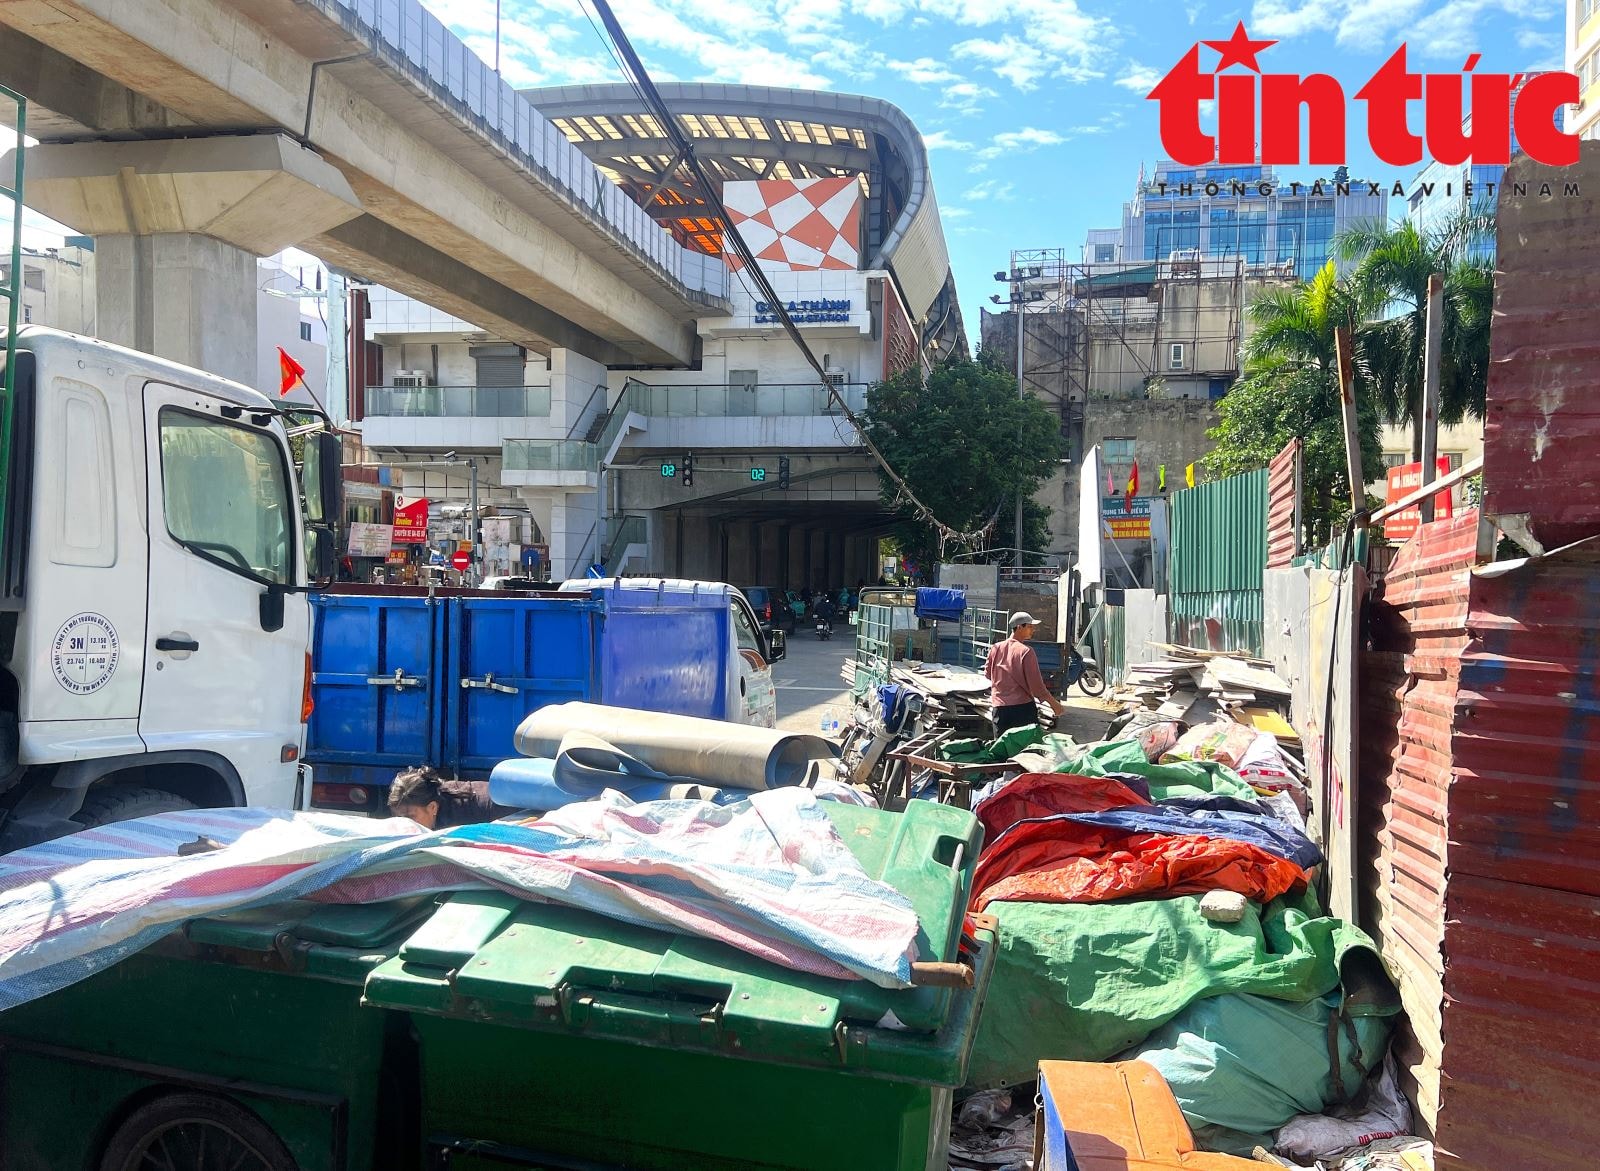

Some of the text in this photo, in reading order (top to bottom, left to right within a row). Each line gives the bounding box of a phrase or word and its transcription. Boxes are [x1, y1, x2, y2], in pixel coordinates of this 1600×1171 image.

[800, 297, 850, 312] THÀNH
[806, 313, 849, 323] STATION
[661, 464, 676, 476] 02
[751, 469, 765, 480] 02
[56, 634, 64, 649] CÔNG
[68, 620, 78, 628] MÔI
[70, 638, 84, 650] 3N
